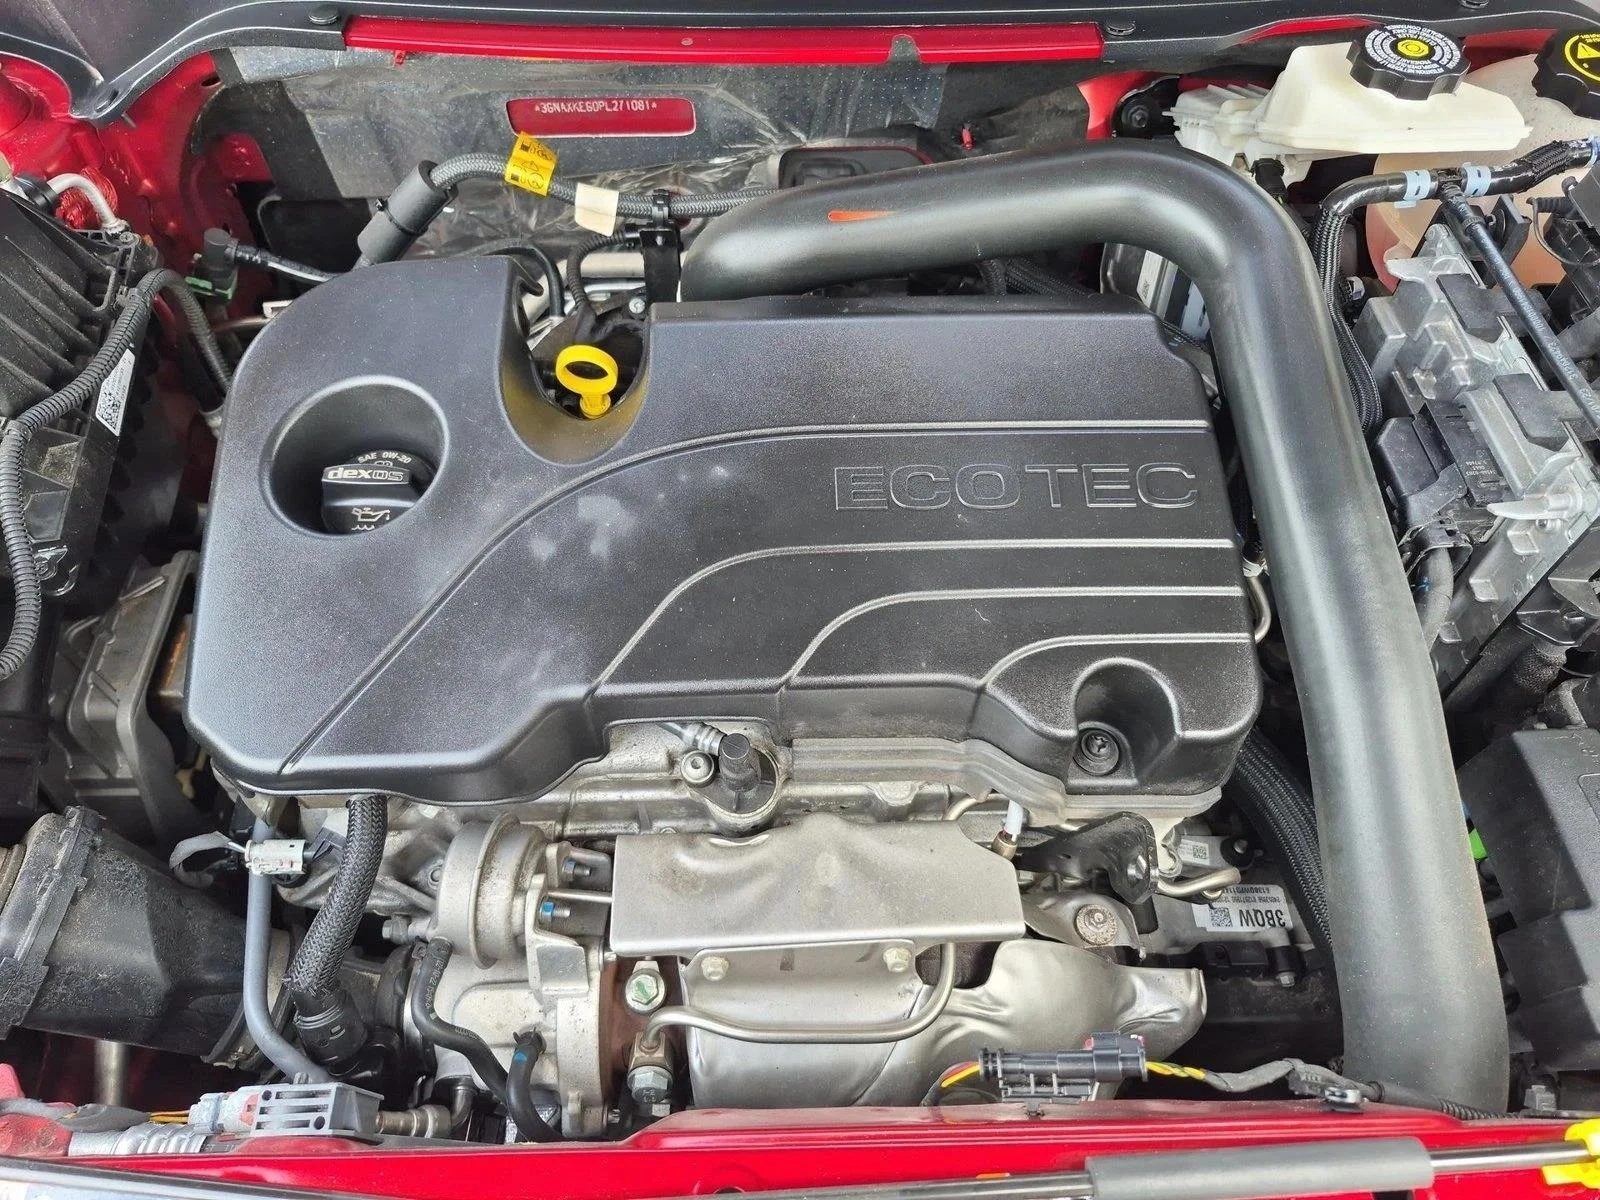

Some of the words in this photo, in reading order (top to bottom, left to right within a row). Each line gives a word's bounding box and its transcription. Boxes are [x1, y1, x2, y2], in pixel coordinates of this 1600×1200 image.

[357, 452, 377, 463] SAE
[382, 451, 412, 464] 0W-20
[327, 468, 404, 481] dexos
[834, 461, 1198, 510] ECOTEC
[1239, 908, 1286, 928] 3BQW
